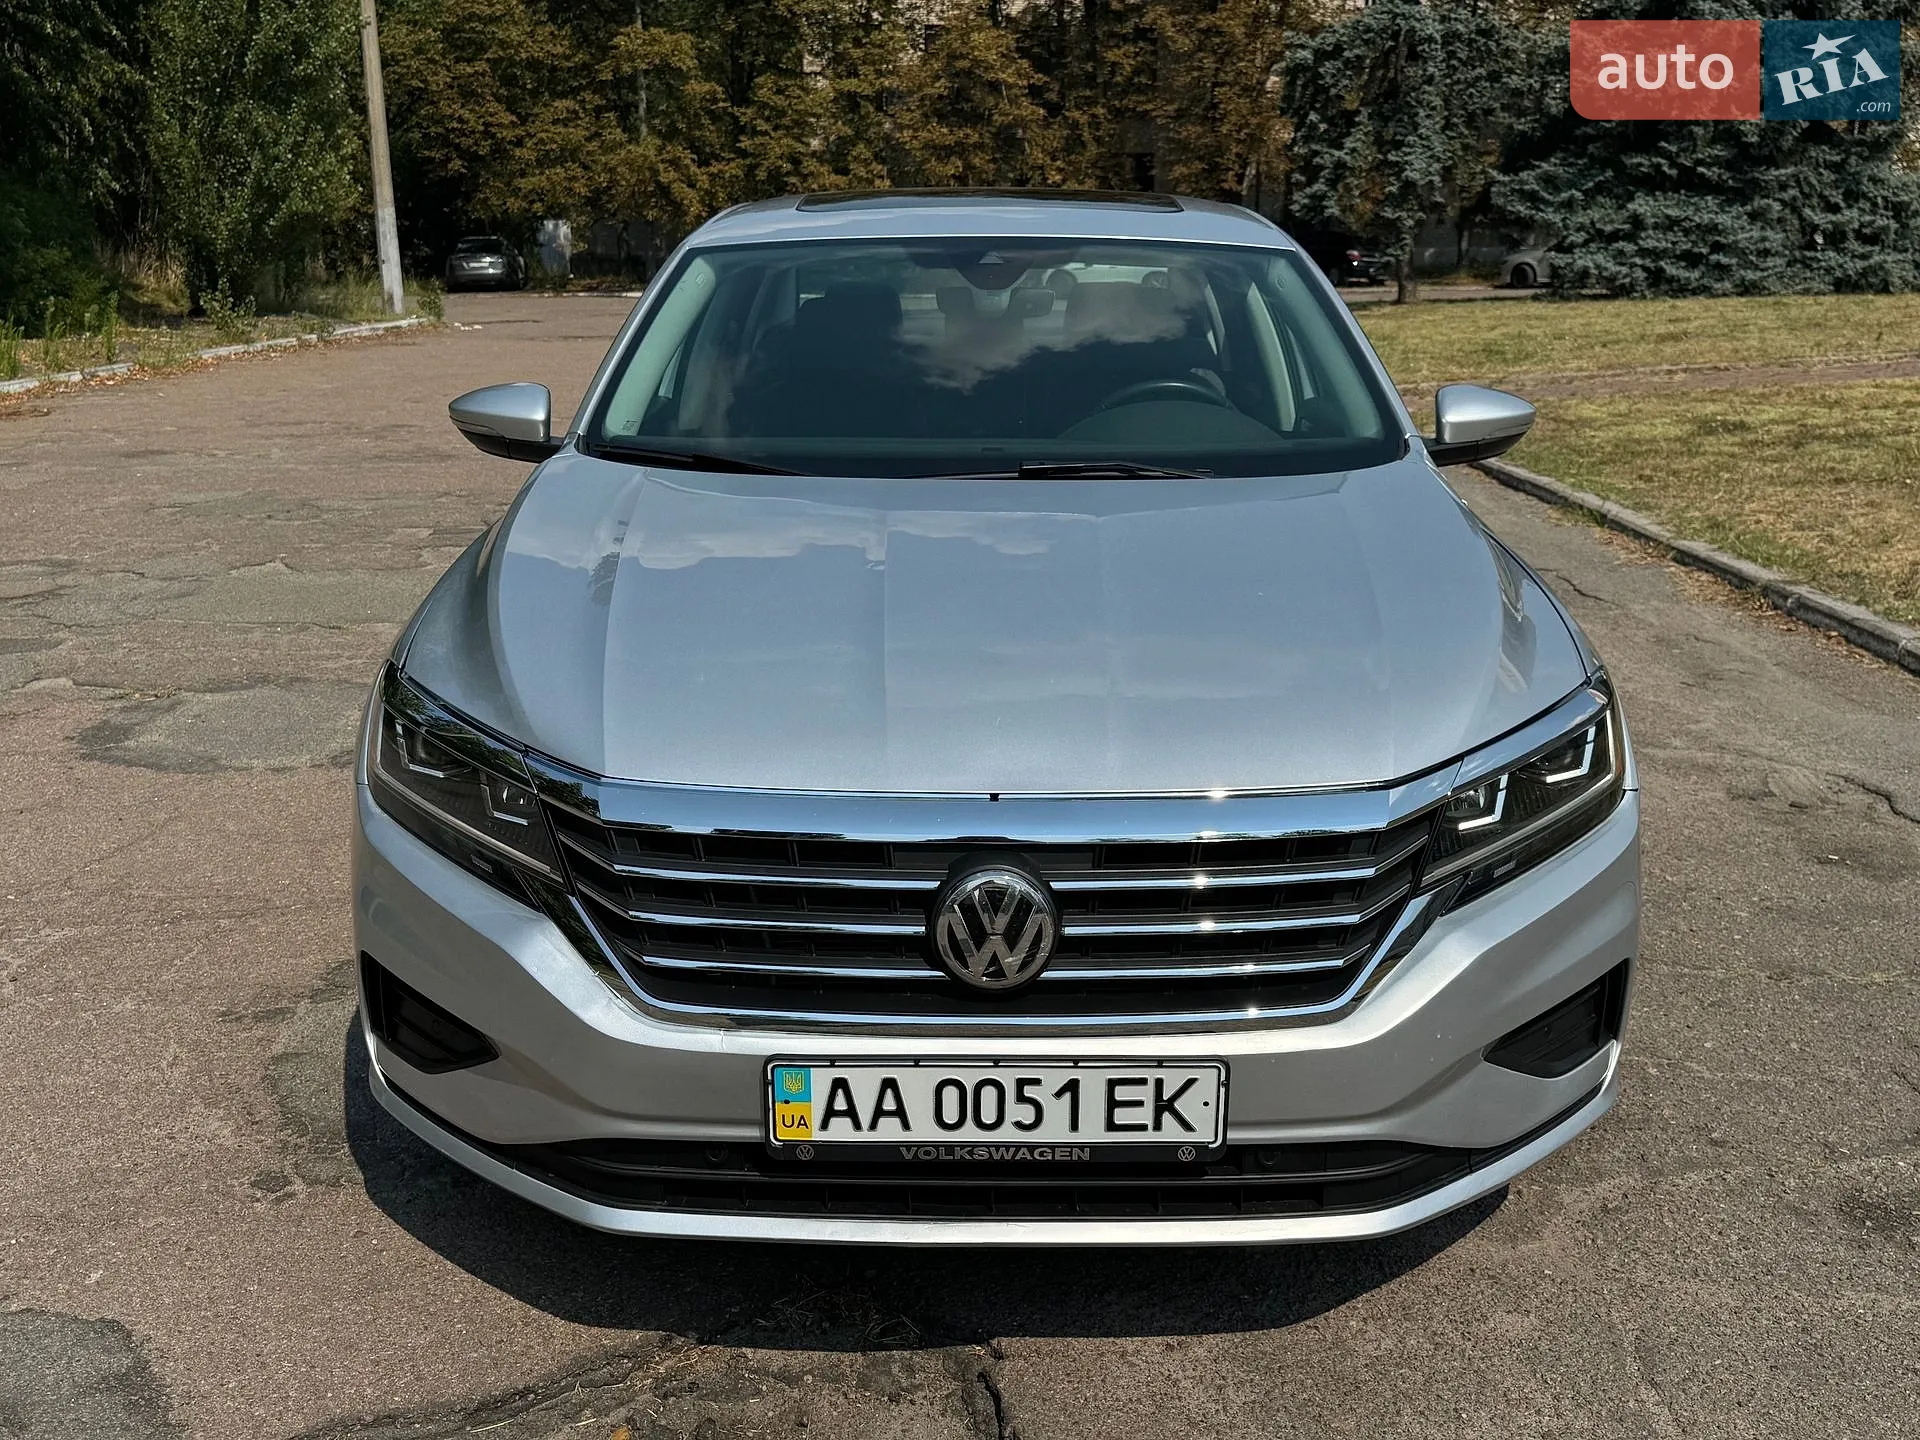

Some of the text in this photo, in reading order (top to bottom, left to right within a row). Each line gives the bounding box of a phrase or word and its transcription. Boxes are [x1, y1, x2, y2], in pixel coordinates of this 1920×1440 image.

[819, 1076, 1200, 1132] AA 0051 EK
[781, 1113, 810, 1130] UA
[900, 1146, 1090, 1161] VOLKSWAGEN
